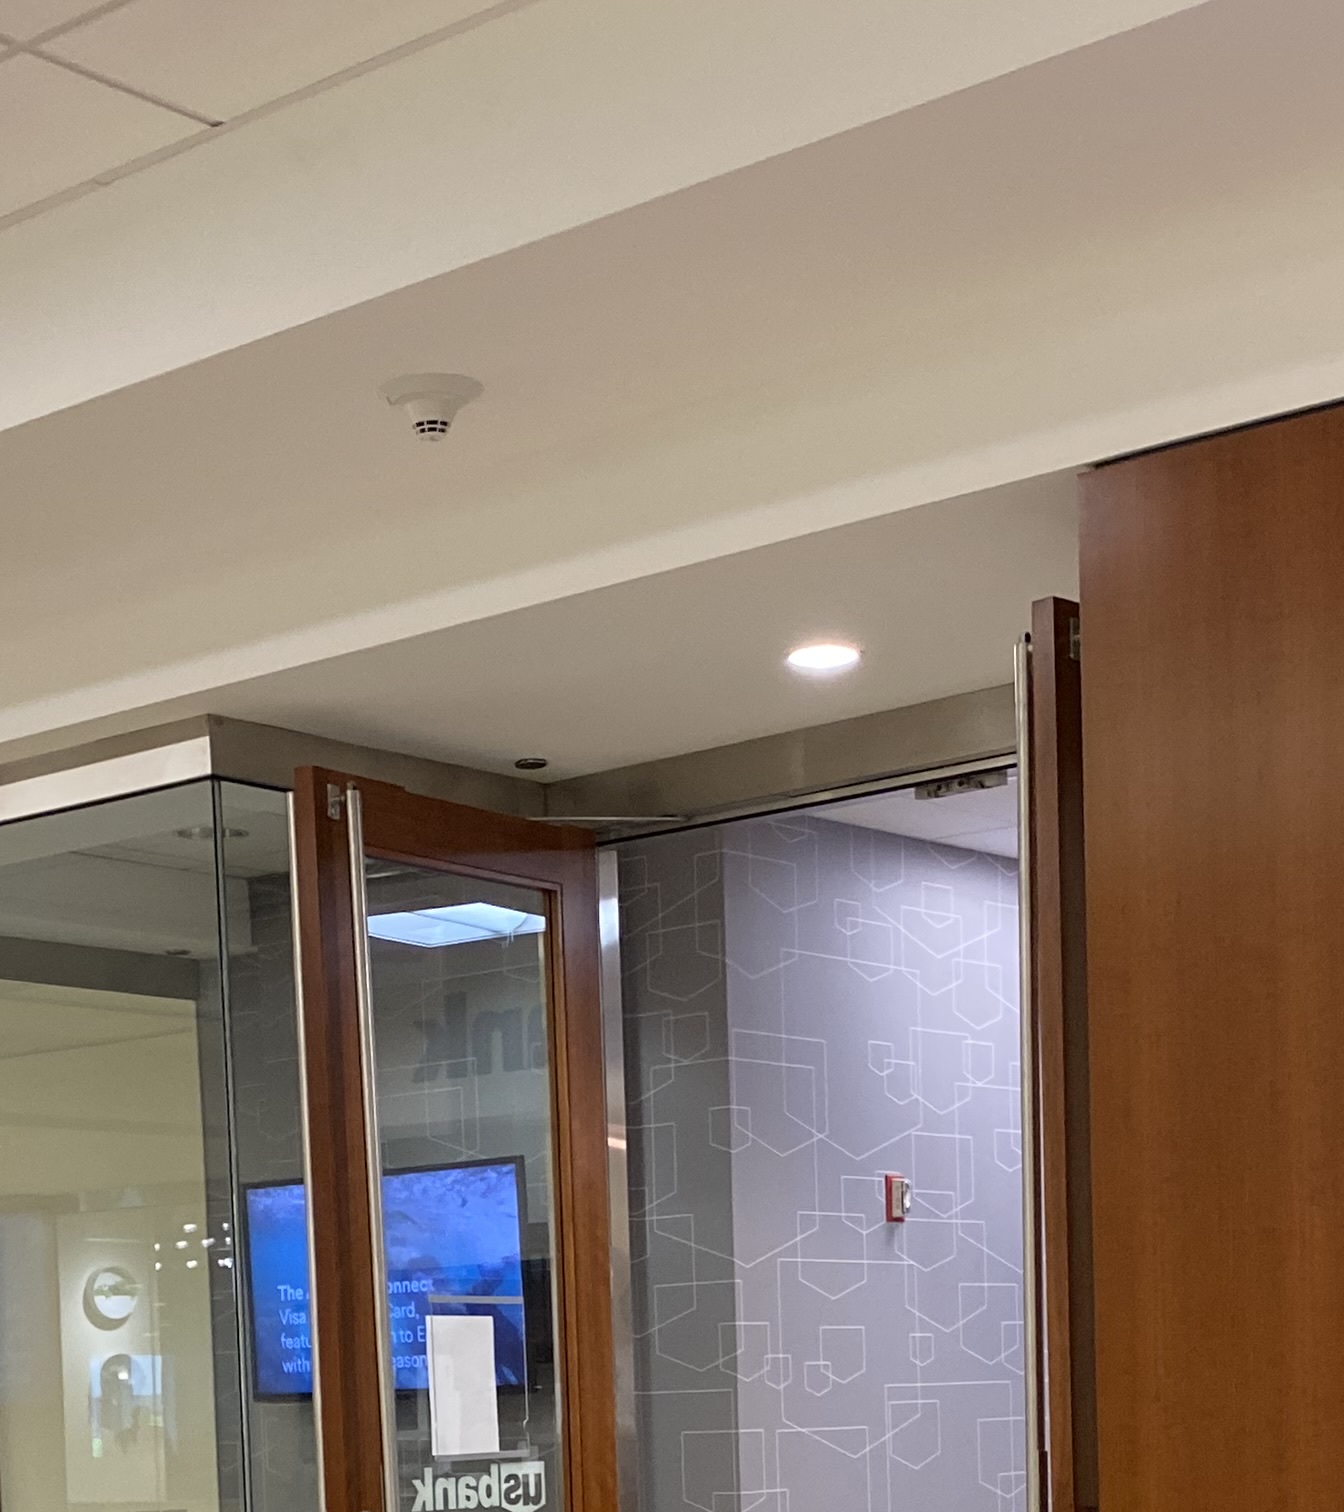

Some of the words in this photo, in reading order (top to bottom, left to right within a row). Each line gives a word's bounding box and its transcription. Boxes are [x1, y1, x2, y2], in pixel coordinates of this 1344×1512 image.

[277, 1285, 304, 1301] The
[279, 1309, 307, 1326] Visa
[389, 1301, 420, 1320] ard,
[400, 1327, 414, 1343] to
